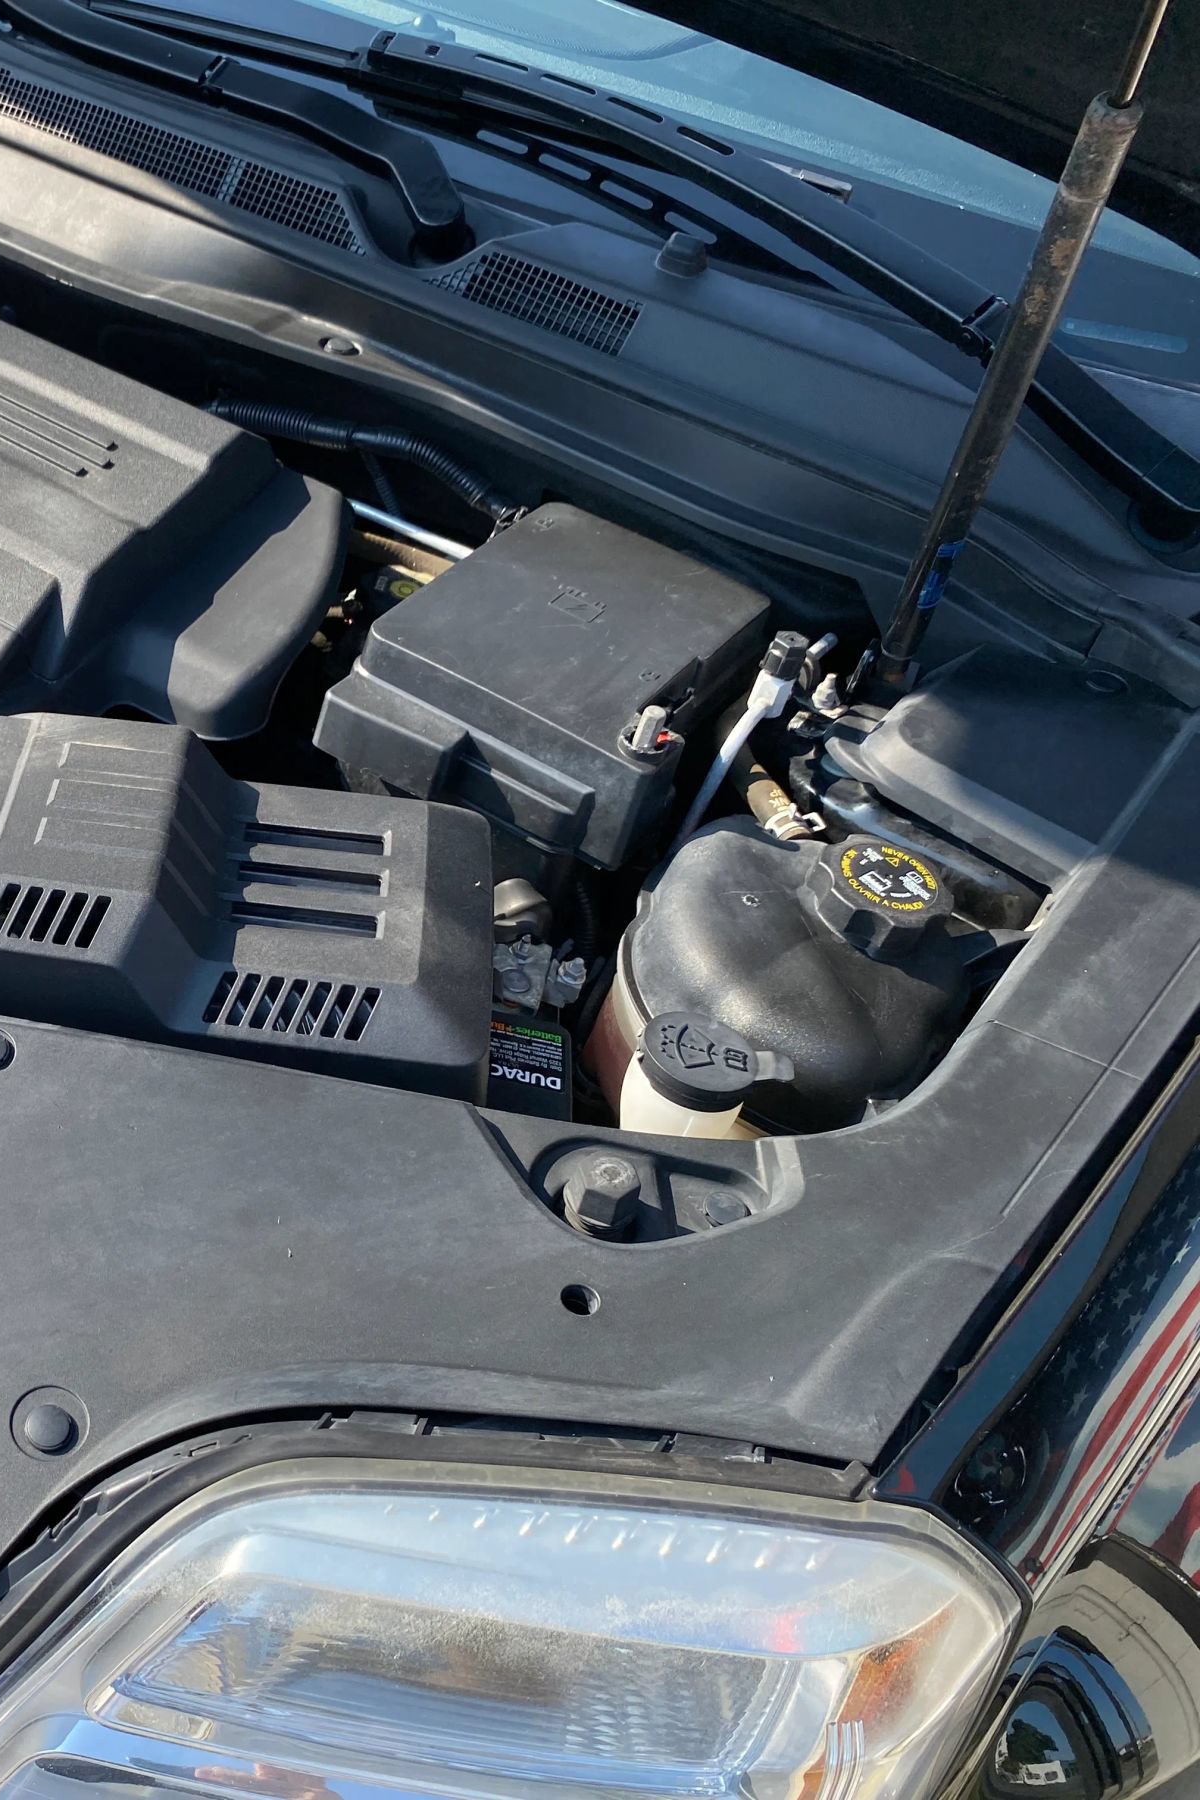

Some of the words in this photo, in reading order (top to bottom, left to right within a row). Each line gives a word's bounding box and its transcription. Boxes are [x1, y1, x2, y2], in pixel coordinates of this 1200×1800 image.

[881, 846, 910, 862] NEVER
[848, 878, 881, 904] OUVRIR
[490, 1063, 562, 1090] DURAC
